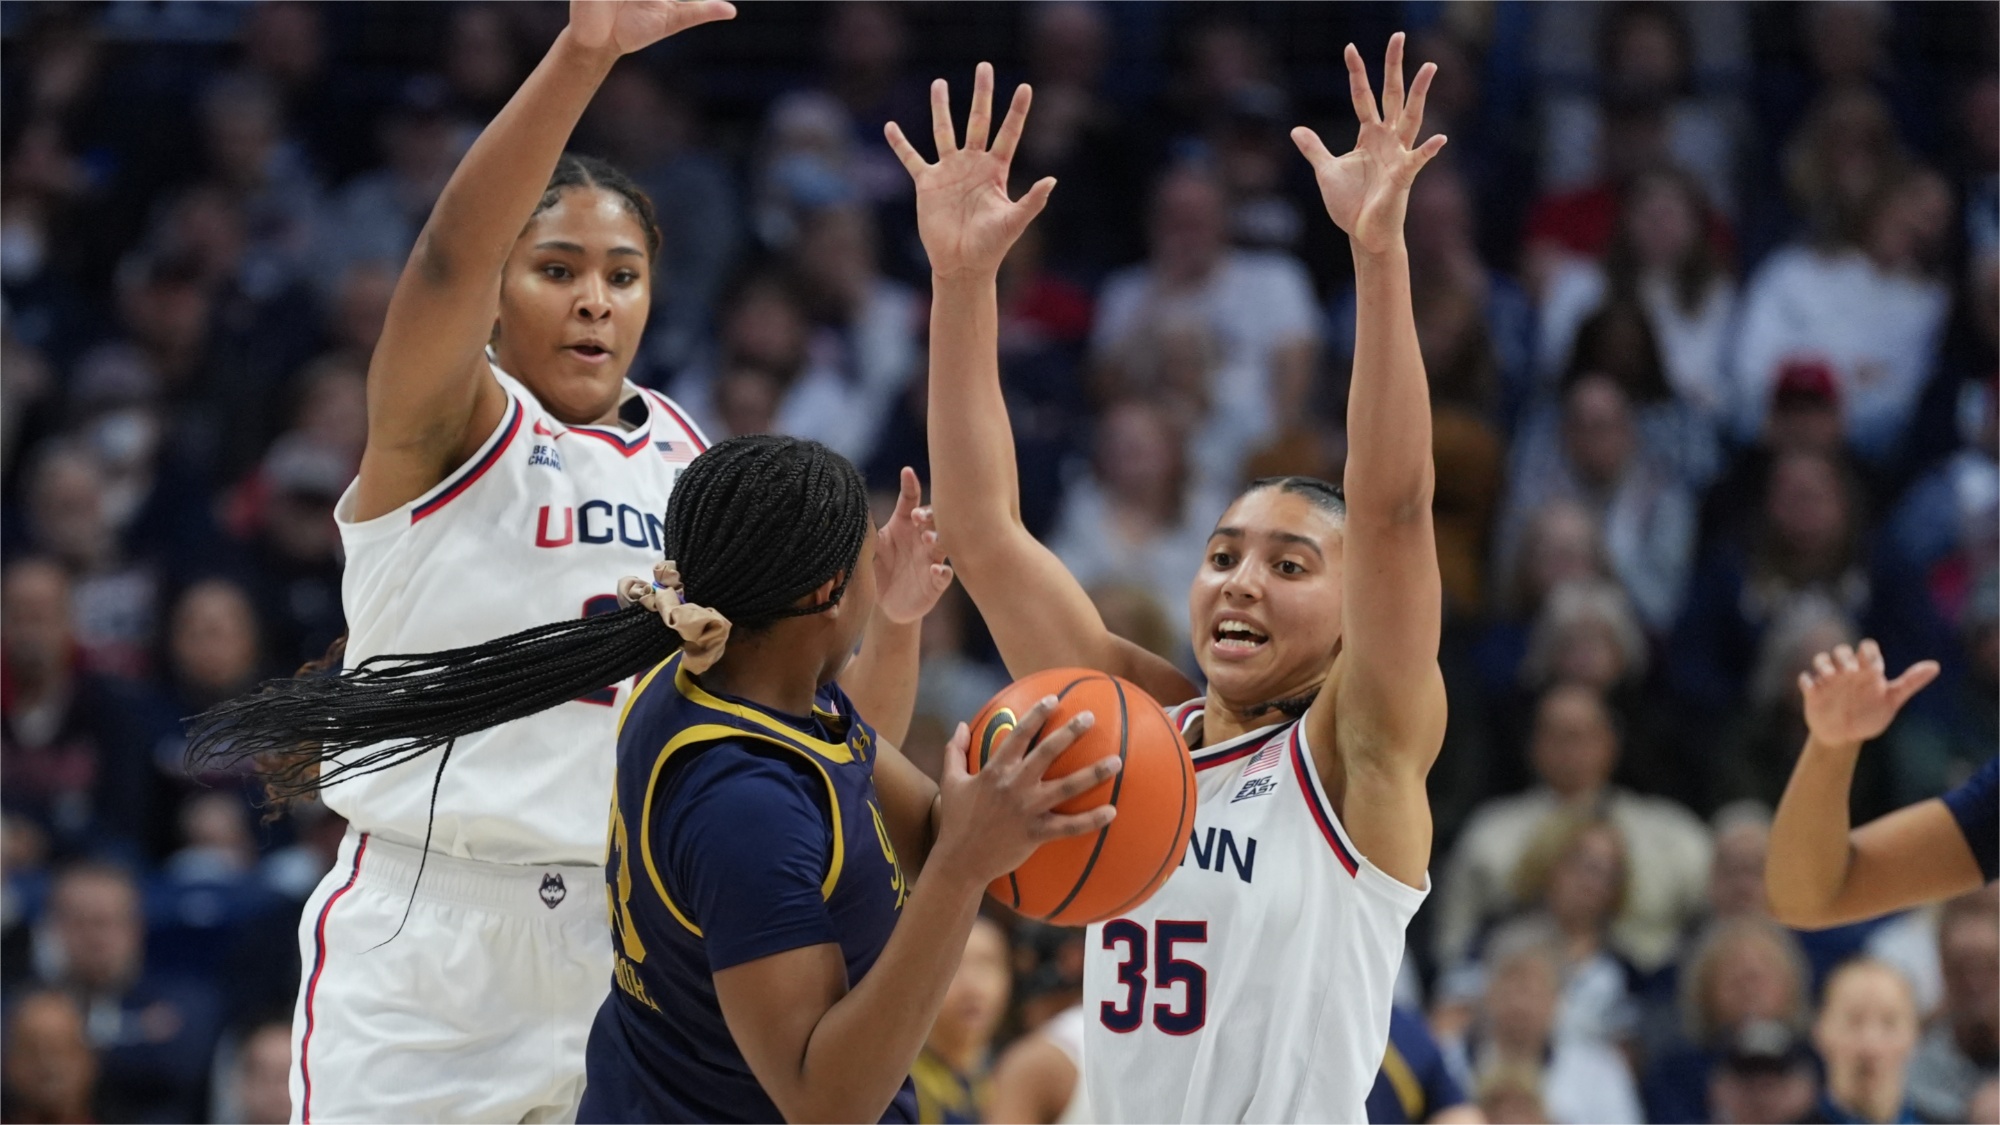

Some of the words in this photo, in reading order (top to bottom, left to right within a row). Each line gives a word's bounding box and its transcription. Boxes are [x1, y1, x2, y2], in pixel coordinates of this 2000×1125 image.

[532, 445, 547, 455] BE
[528, 455, 562, 471] CHANG
[535, 499, 665, 551] UCON
[1235, 782, 1278, 798] EAST
[1242, 775, 1272, 790] BIG
[1100, 918, 1207, 1036] 35
